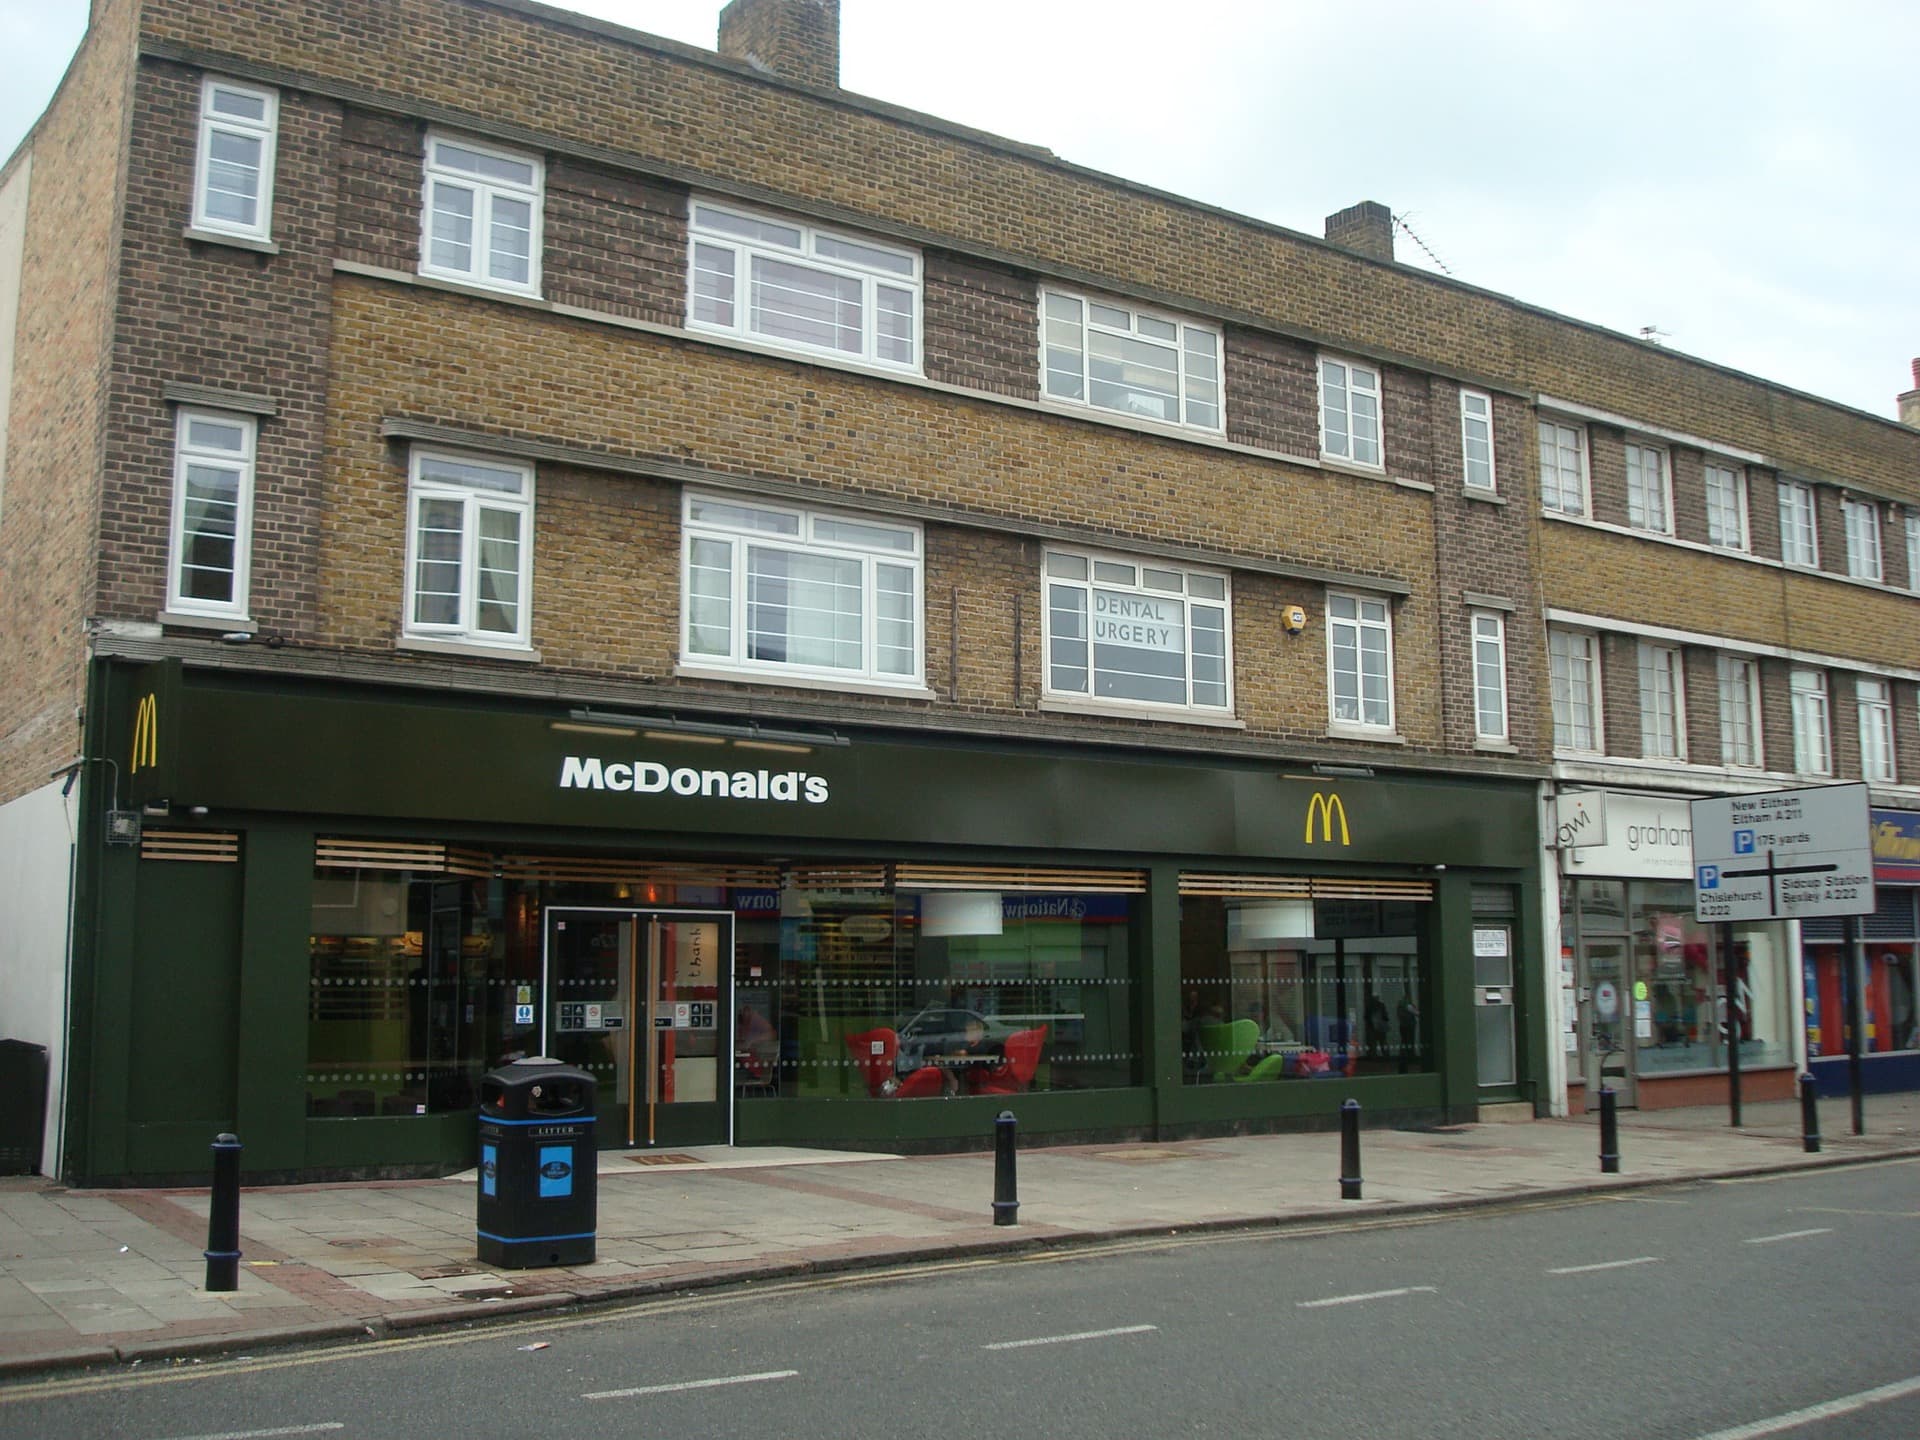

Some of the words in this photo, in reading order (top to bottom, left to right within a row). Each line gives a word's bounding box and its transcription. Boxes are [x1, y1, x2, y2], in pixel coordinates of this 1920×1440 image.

[1096, 595, 1164, 620] DENTAL
[1095, 620, 1169, 646] URGERY
[559, 756, 829, 803] McDonald's
[1732, 801, 1757, 811] New
[1761, 797, 1801, 809] Eltham
[1559, 802, 1592, 848] gwi
[1732, 813, 1772, 825] Eltham
[1757, 834, 1776, 846] 175
[1778, 832, 1811, 846] yards
[1781, 878, 1822, 890] Sidcup
[1824, 875, 1869, 887] Station
[1700, 890, 1763, 904] Chislehurst
[1783, 891, 1819, 904] Bexley
[539, 1126, 575, 1136] LITTER
